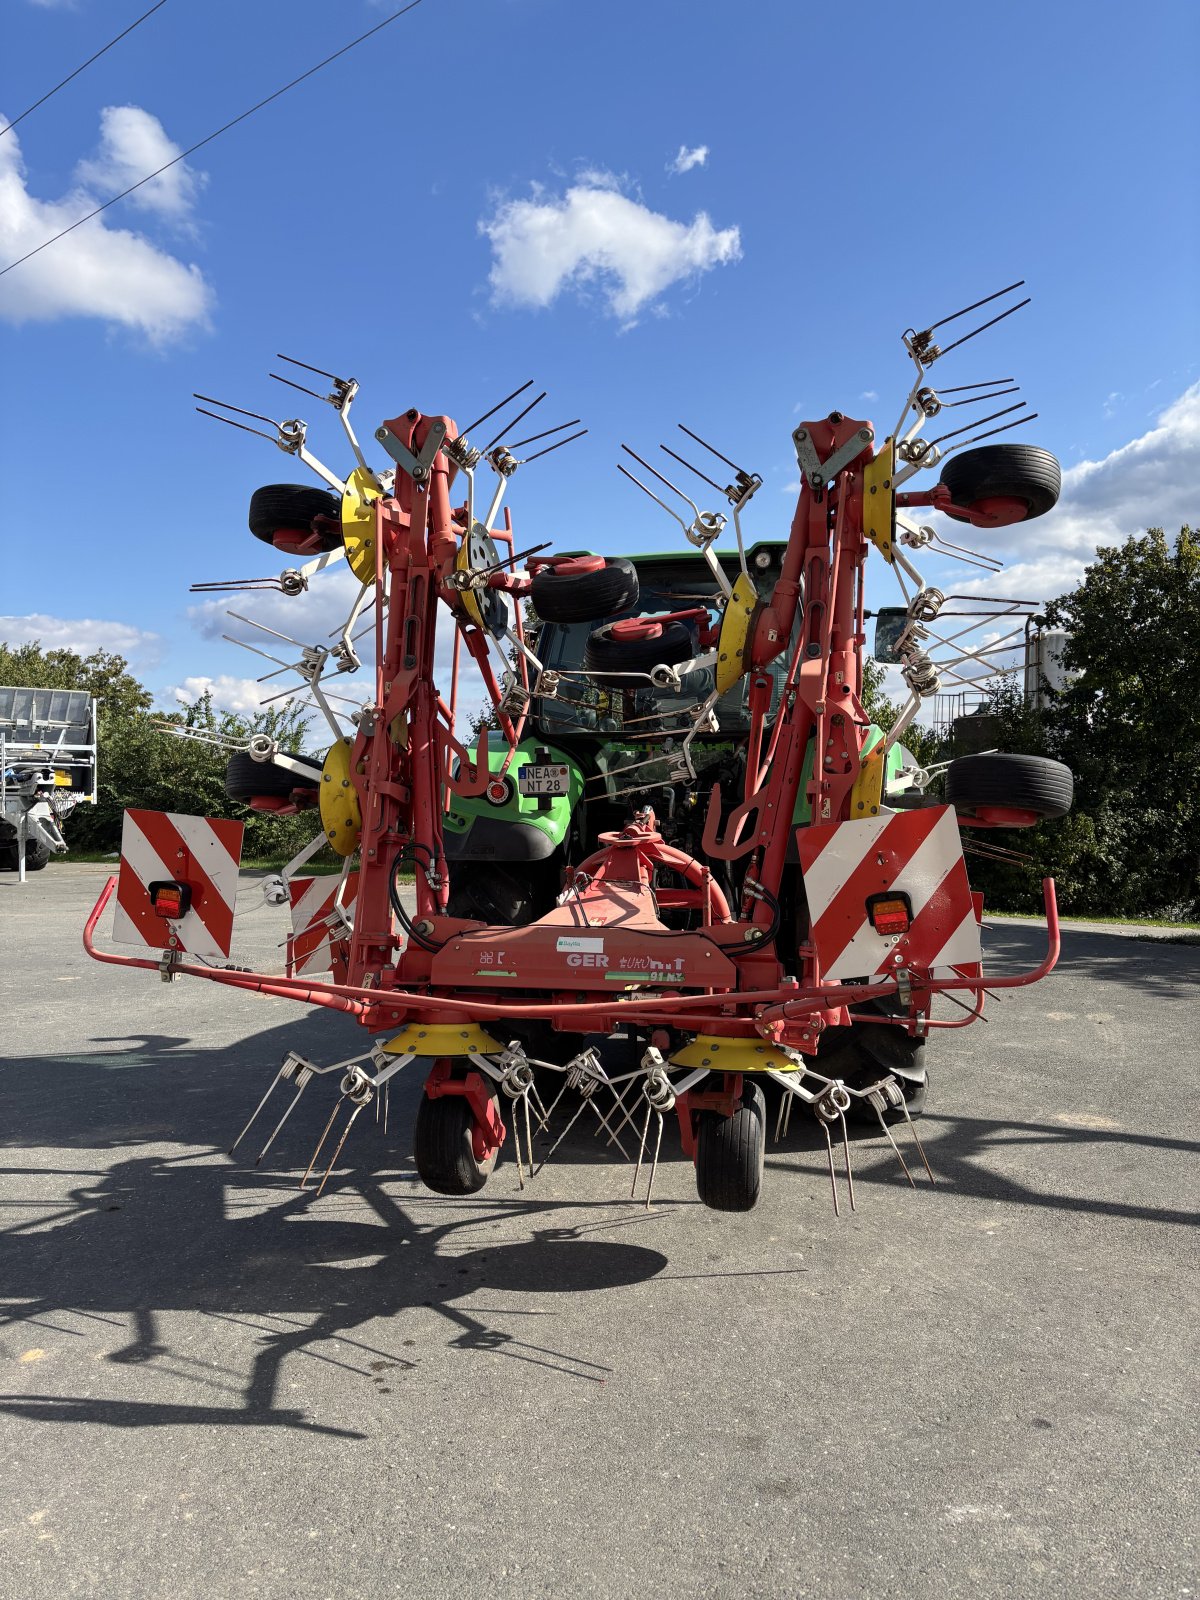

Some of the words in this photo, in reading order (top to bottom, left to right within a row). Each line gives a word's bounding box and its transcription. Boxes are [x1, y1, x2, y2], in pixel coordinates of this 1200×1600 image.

[527, 768, 550, 779] NEA
[527, 780, 542, 791] NT
[546, 780, 560, 791] 28
[650, 972, 663, 981] 91
